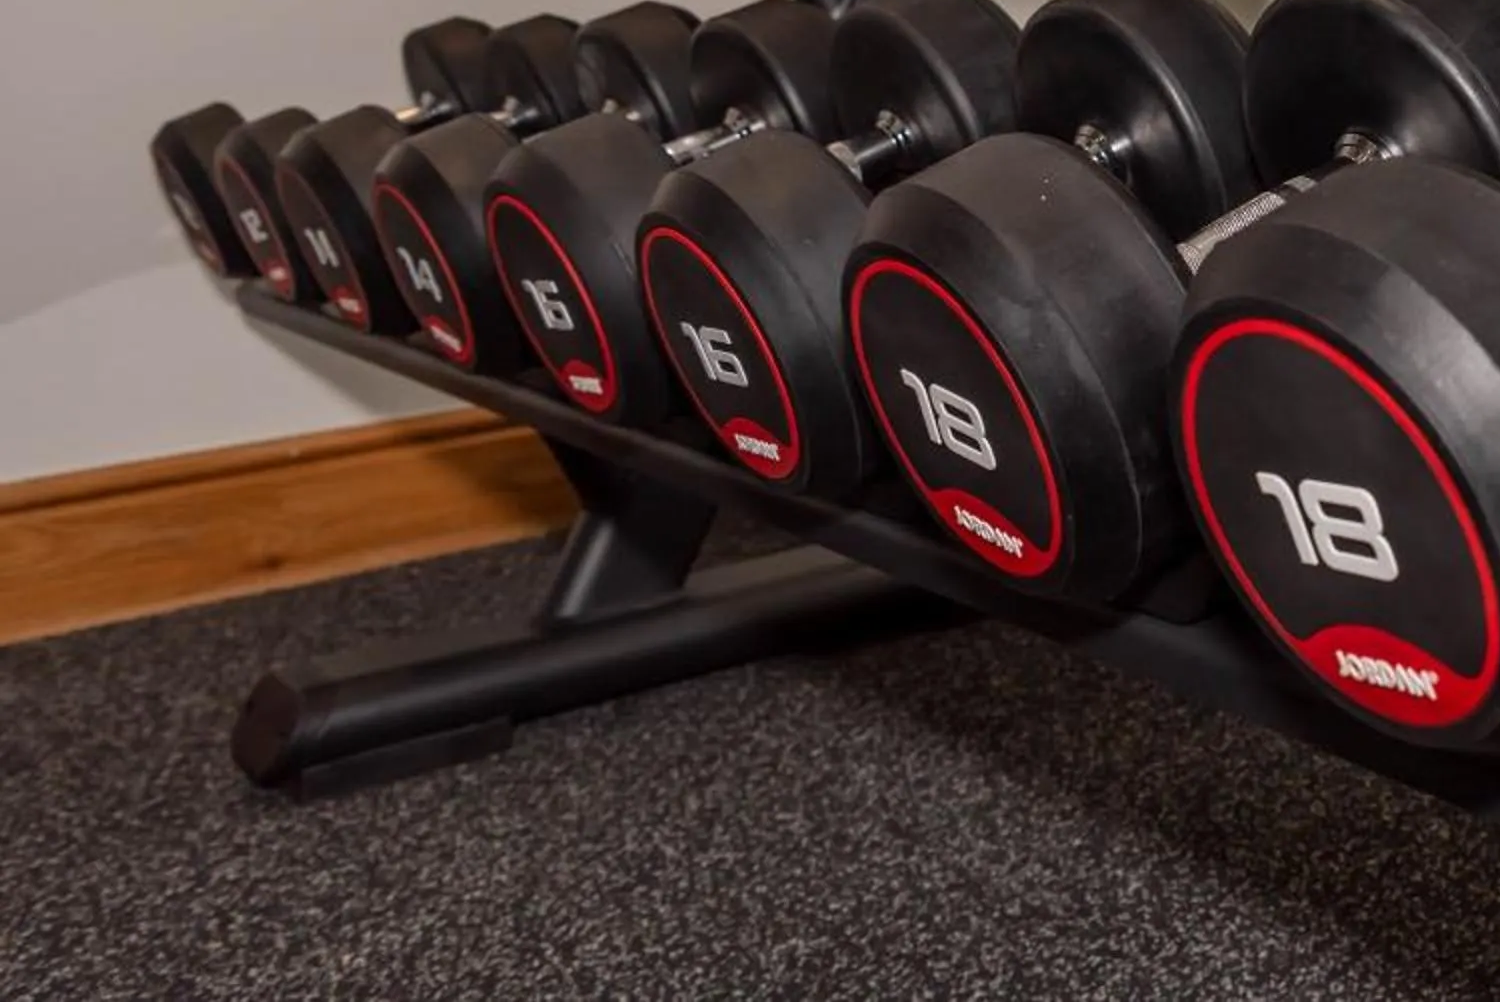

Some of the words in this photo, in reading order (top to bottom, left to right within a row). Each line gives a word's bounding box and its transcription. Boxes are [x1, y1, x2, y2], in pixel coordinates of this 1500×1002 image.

[521, 279, 575, 330] 16
[680, 321, 749, 387] 16
[900, 368, 997, 472] 18
[1255, 471, 1399, 582] 18
